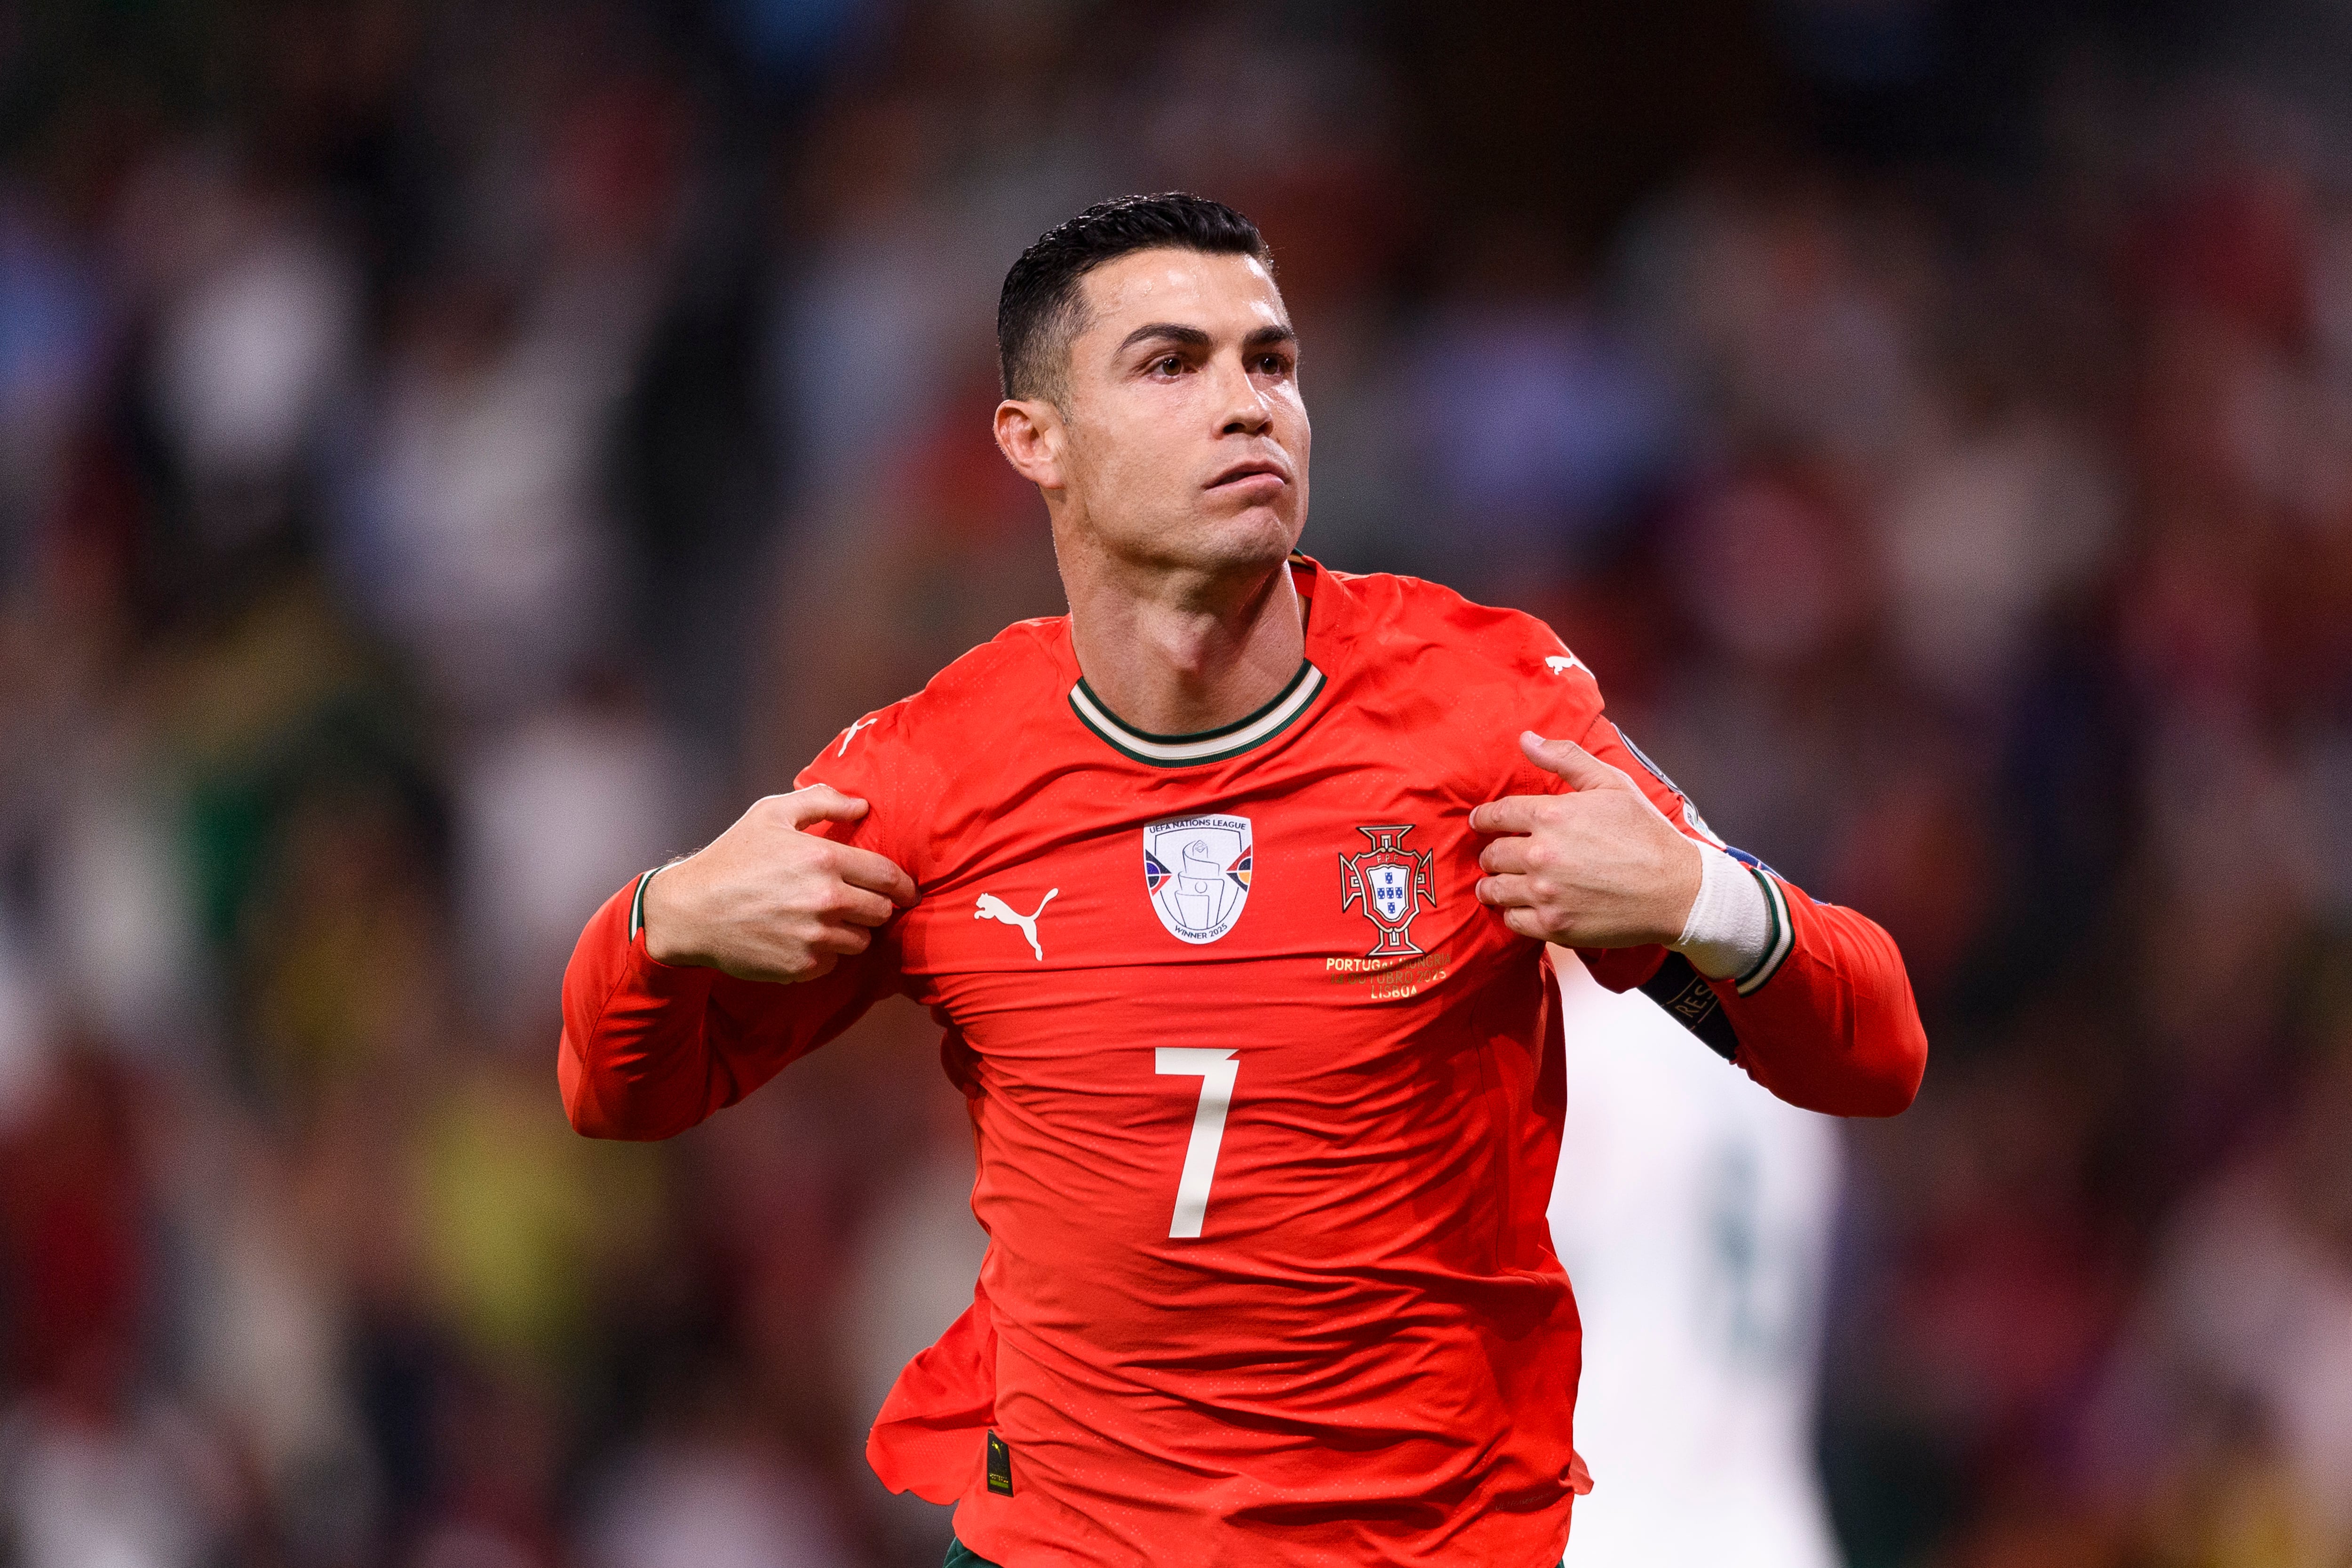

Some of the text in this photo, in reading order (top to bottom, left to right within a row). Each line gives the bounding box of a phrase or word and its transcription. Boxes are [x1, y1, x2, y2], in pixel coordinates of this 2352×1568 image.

[1149, 819, 1247, 833] UEFA NATIONS LEAGUE
[1175, 923, 1227, 939] WINNER 2025
[1348, 971, 1413, 985] OUTUBRO
[1416, 967, 1447, 983] 2025
[1371, 984, 1418, 999] LISBOA
[1155, 1047, 1240, 1238] 7
